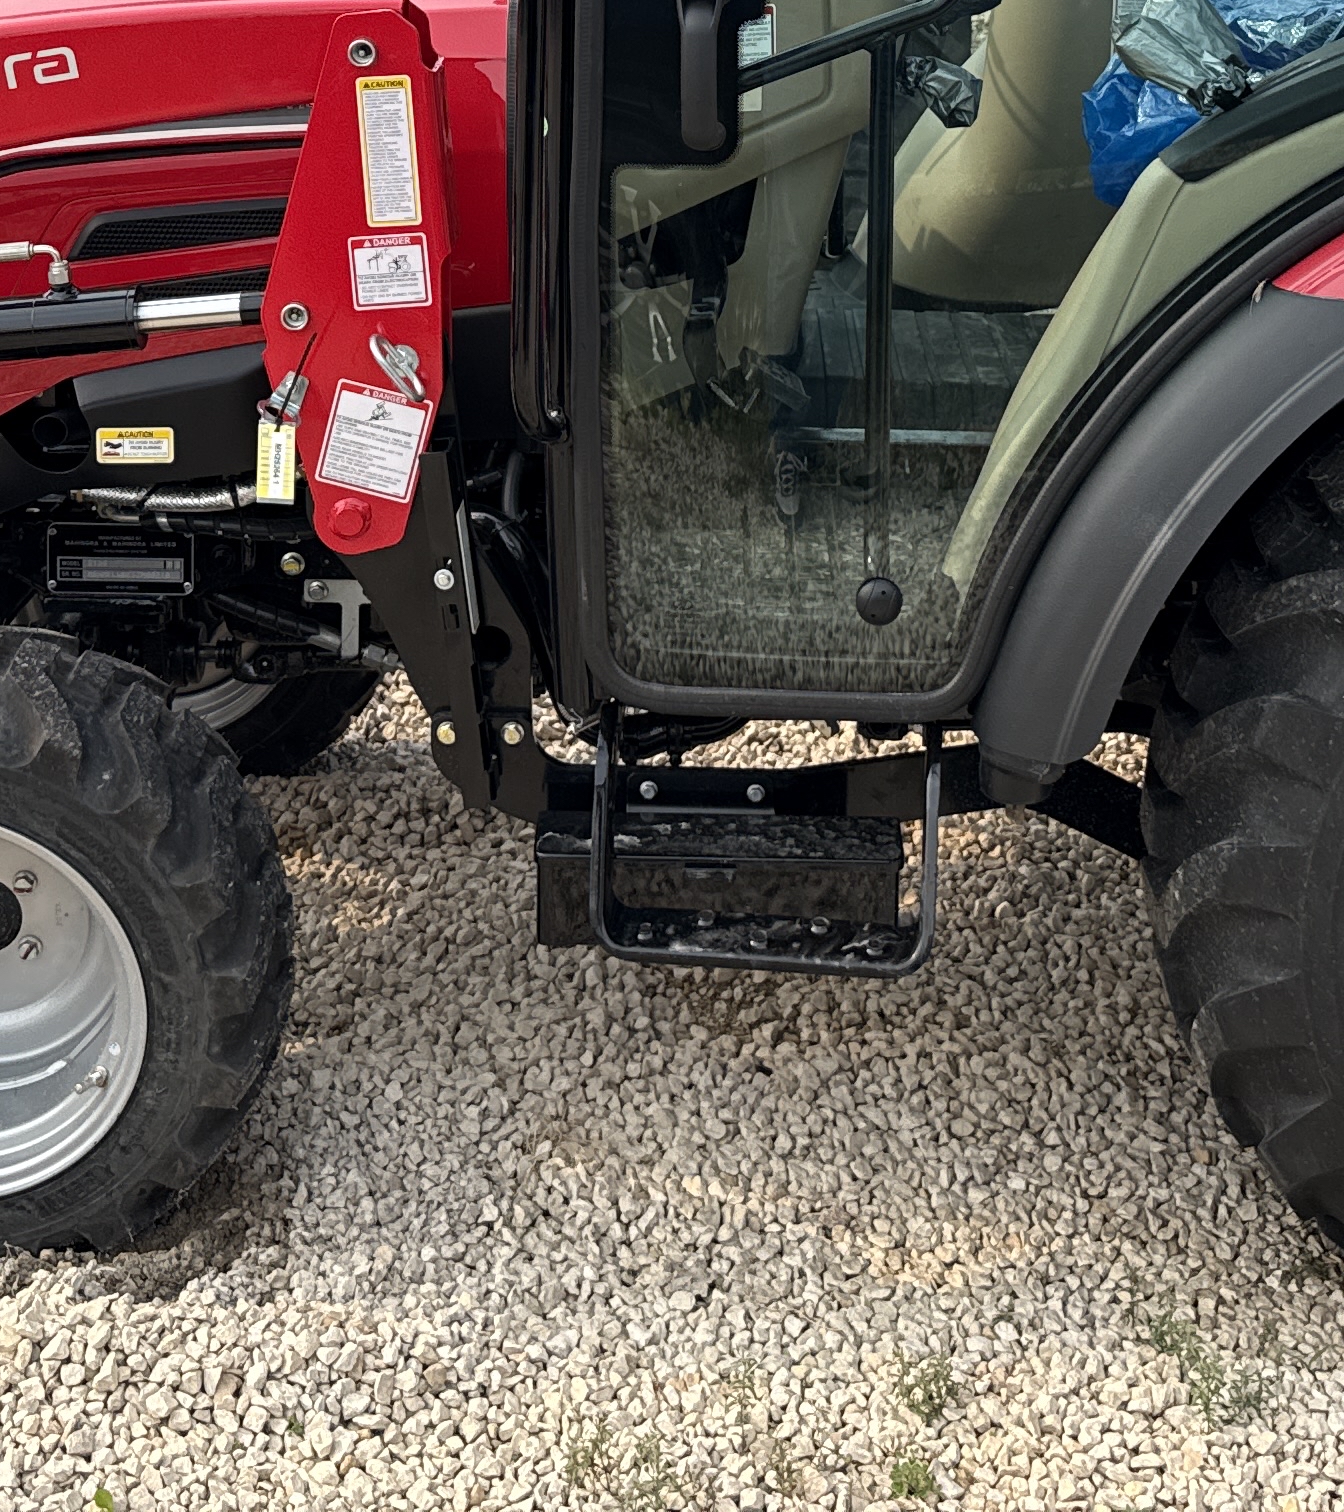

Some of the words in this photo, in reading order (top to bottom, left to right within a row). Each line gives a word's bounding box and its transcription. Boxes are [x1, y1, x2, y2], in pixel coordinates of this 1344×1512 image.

[370, 80, 404, 88] CAUTION
[372, 236, 412, 247] DANGER
[372, 390, 408, 406] DANGER
